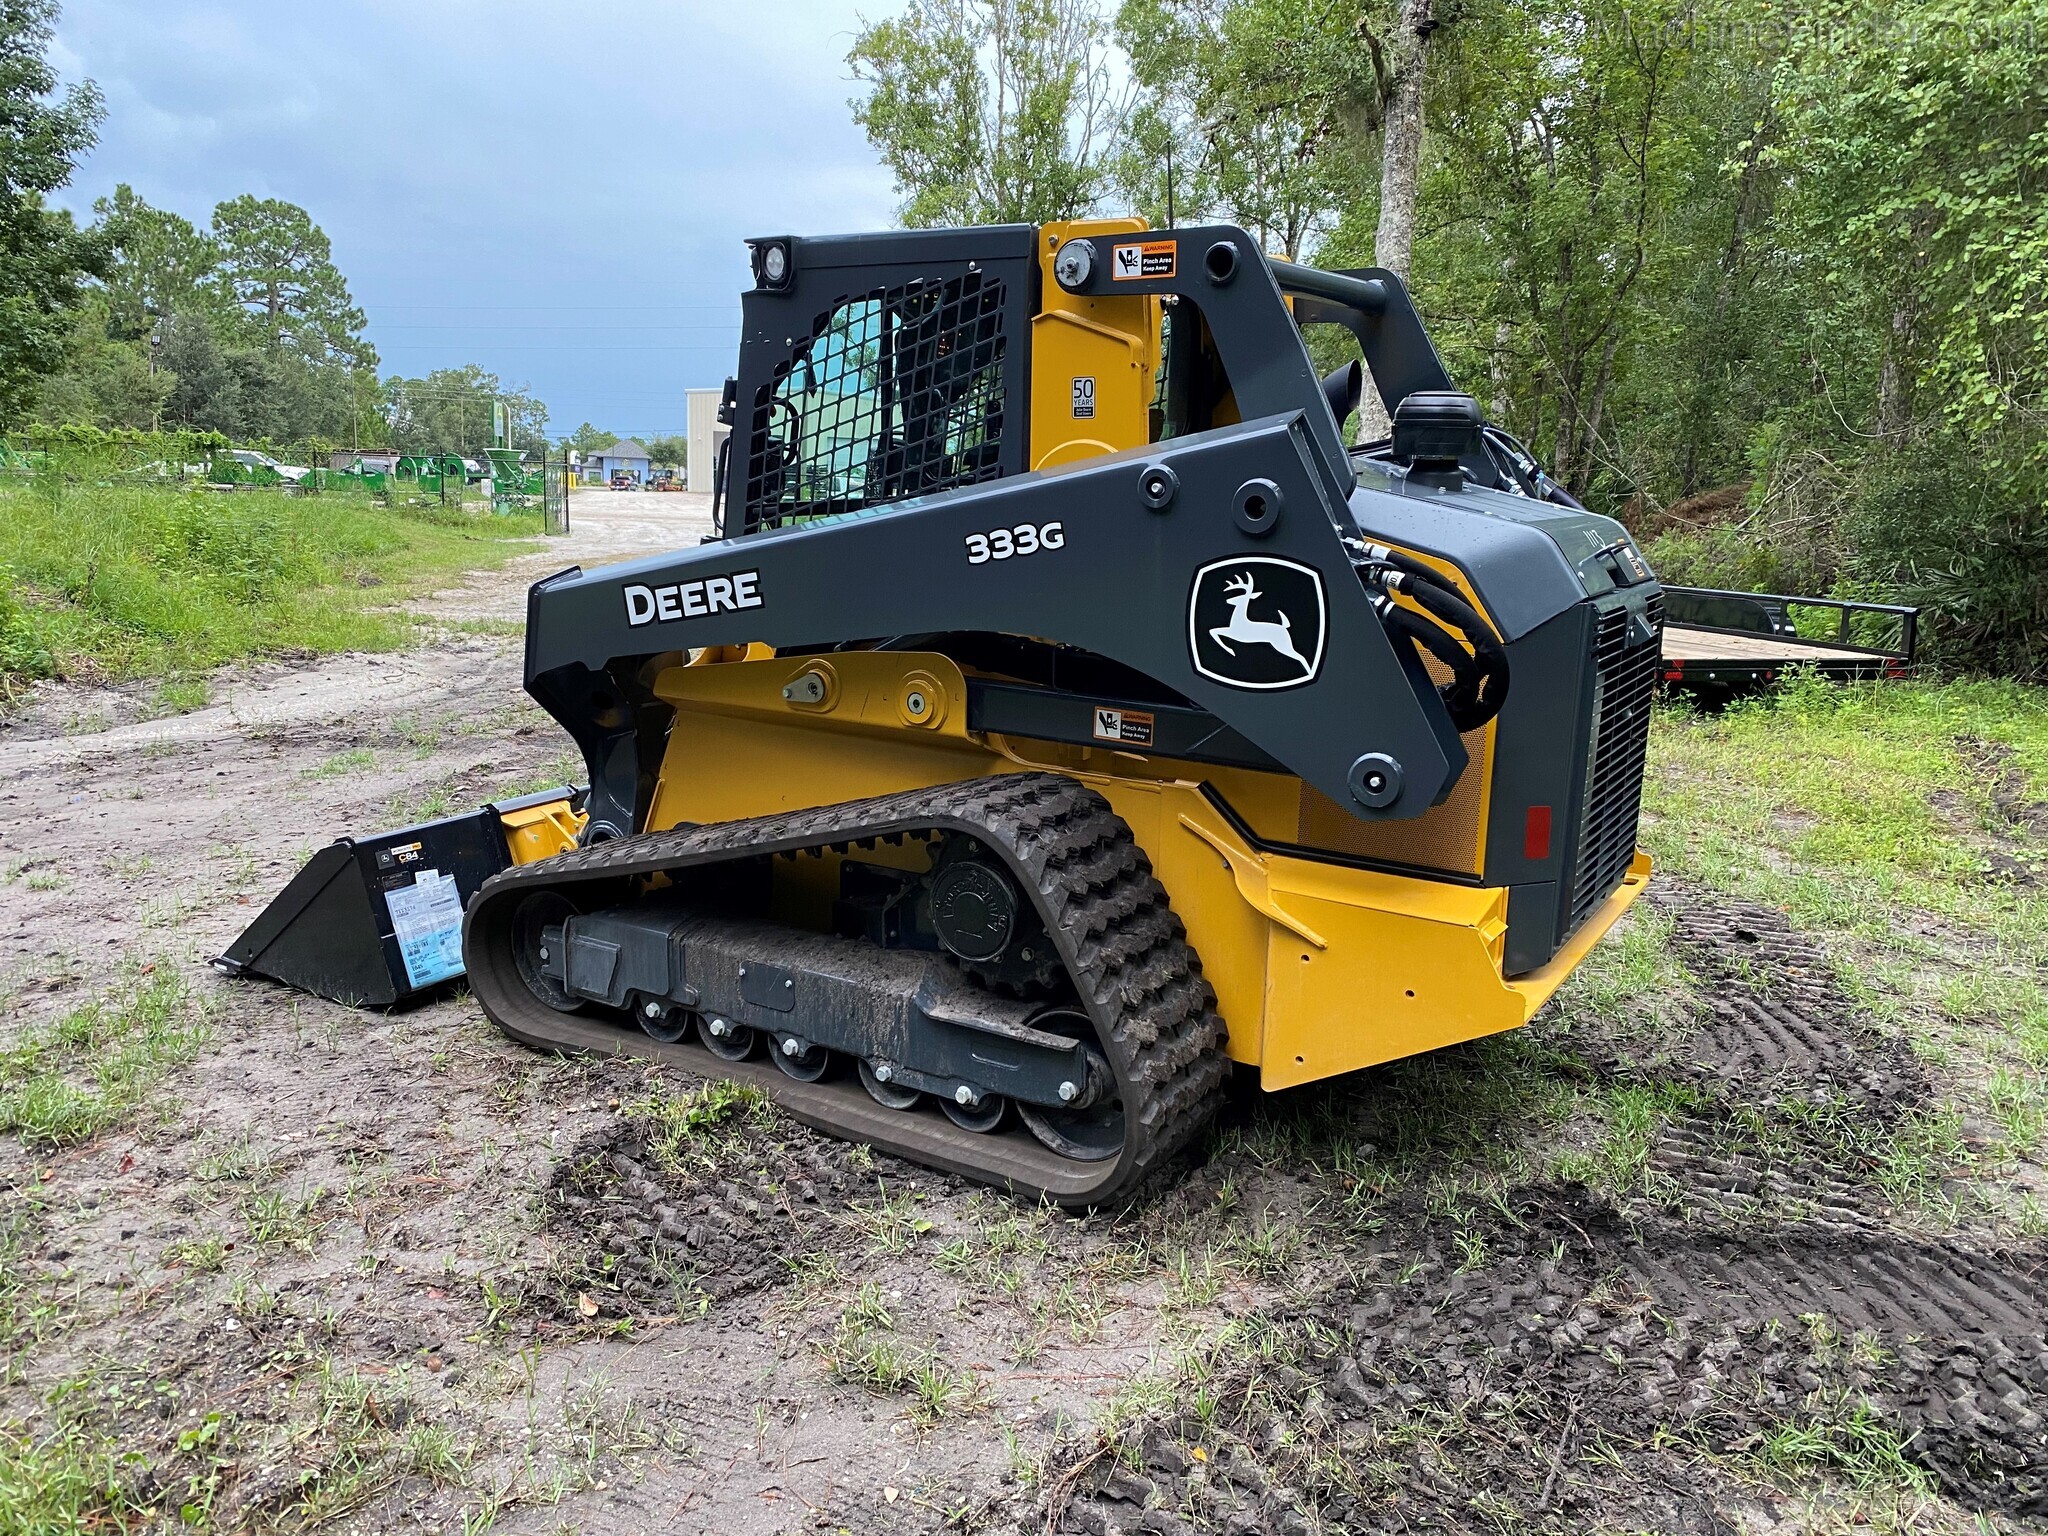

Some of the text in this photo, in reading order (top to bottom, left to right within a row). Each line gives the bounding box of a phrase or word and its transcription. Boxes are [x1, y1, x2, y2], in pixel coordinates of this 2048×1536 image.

[1073, 379, 1094, 399] 50
[1073, 398, 1094, 406] YEARS
[965, 521, 1065, 564] 333G
[624, 571, 762, 626] DEERE
[398, 850, 419, 861] C84
